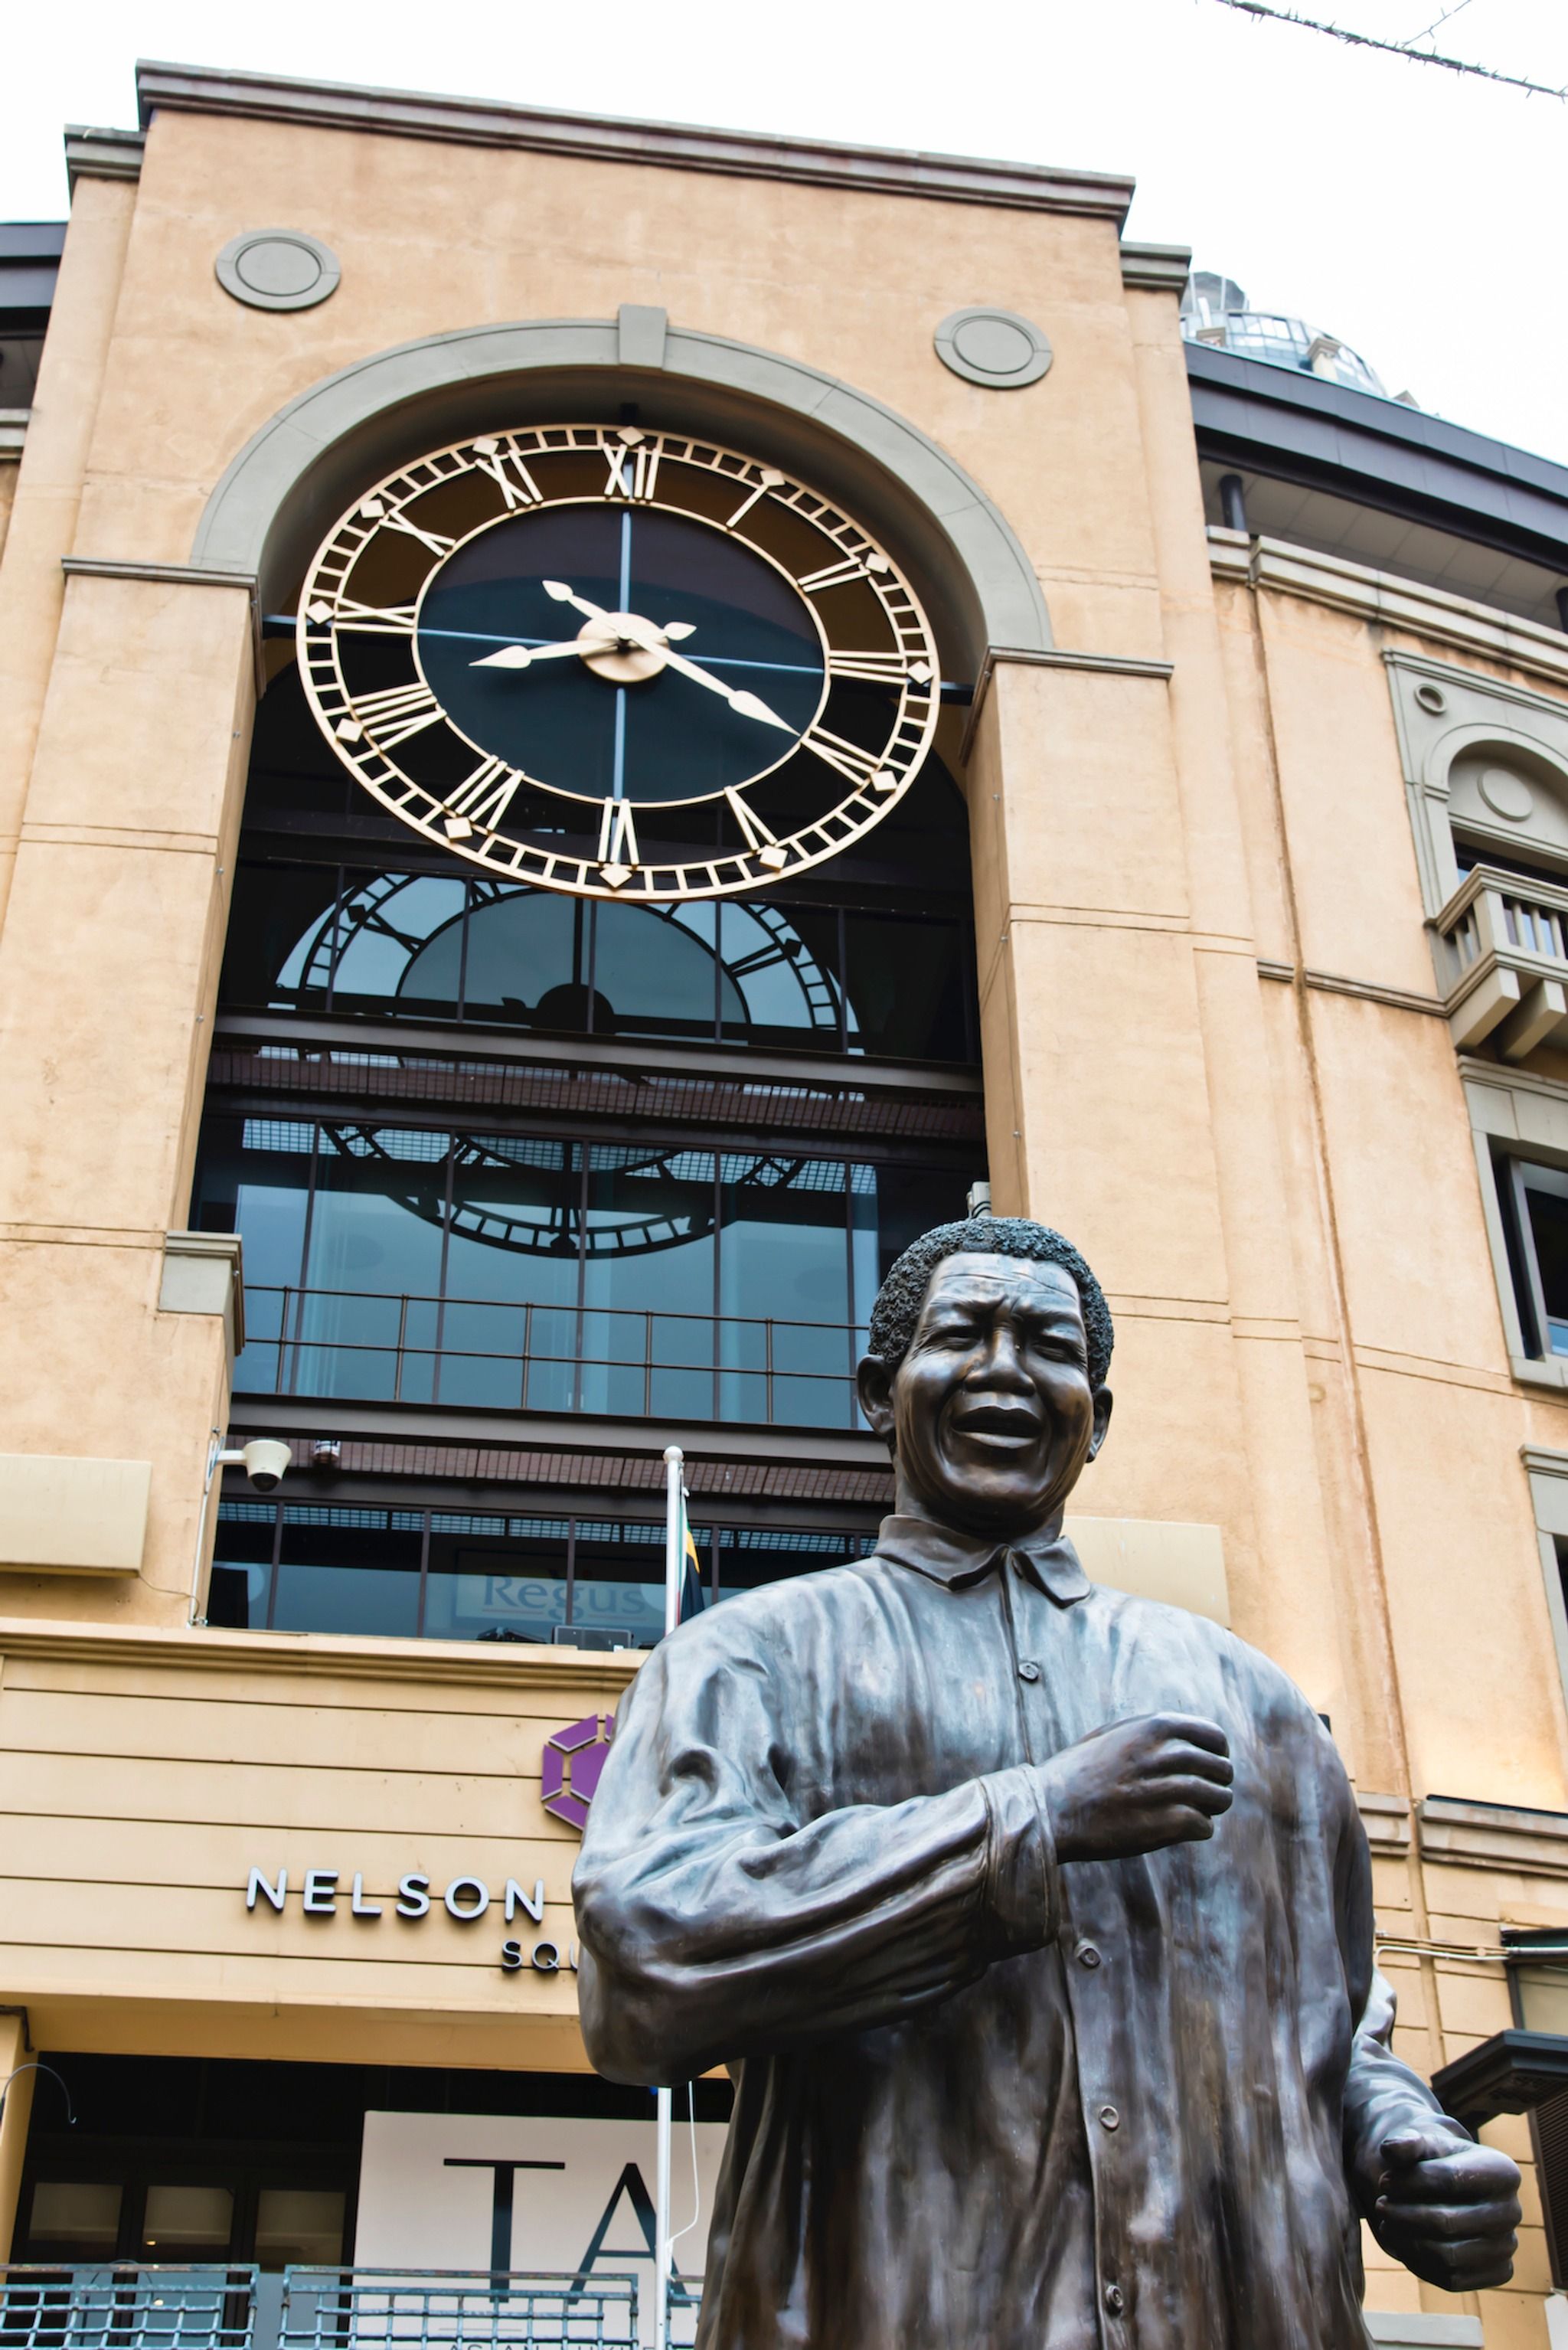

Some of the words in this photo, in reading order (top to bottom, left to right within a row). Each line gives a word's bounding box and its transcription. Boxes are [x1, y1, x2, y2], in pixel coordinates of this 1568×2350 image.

[476, 447, 543, 511] XI
[602, 443, 661, 502] XII
[378, 508, 456, 557] X
[335, 597, 416, 634] IX
[829, 649, 908, 685] III
[350, 685, 446, 752] VIII
[805, 724, 879, 787] IV
[443, 753, 525, 833] VII
[596, 796, 640, 866] VI
[483, 1573, 647, 1621] Regus
[246, 1866, 544, 1923] NELSON
